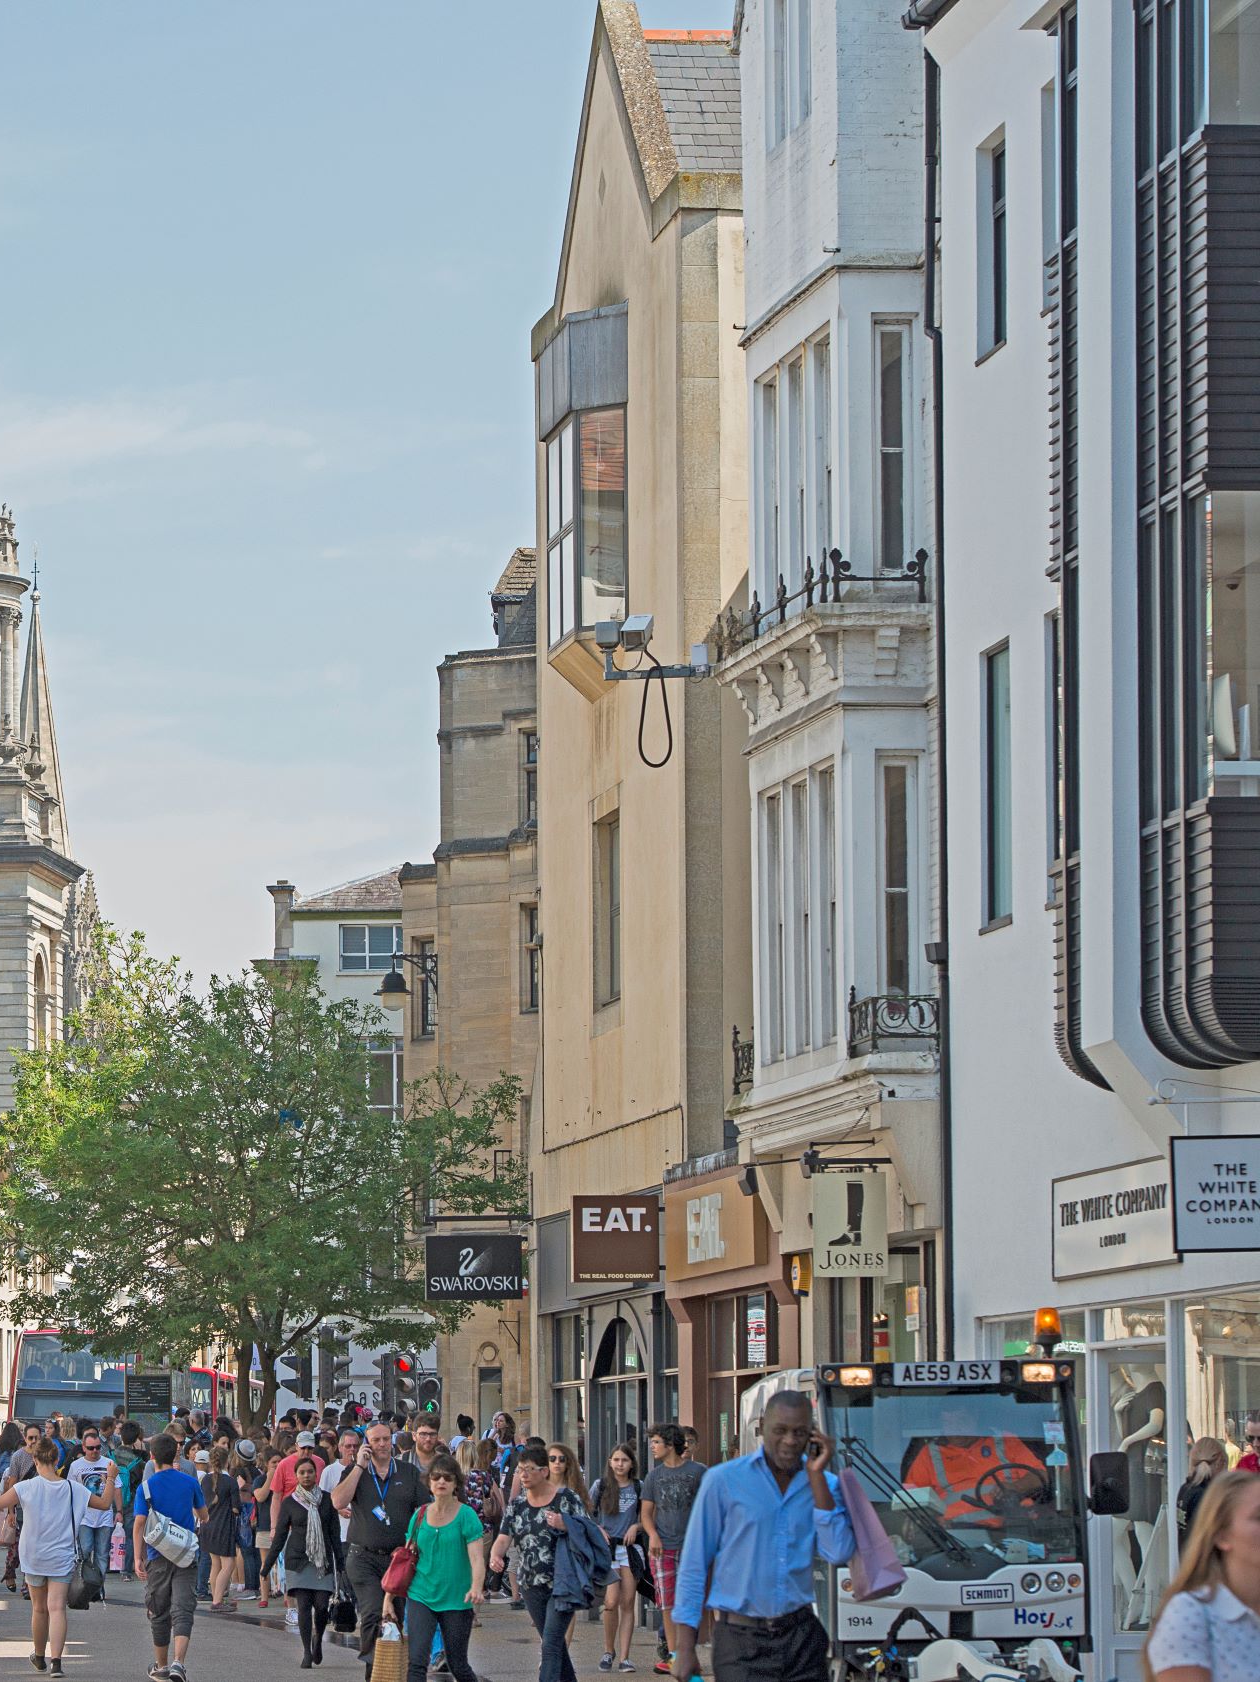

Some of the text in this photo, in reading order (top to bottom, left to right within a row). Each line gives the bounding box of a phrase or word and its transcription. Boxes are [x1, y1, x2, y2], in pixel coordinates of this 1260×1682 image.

[1213, 1163, 1248, 1176] THE
[1198, 1181, 1257, 1194] WHITE
[1060, 1183, 1167, 1227] THE WHITE COMPANY
[1186, 1200, 1260, 1213] COMPAN
[581, 1207, 652, 1232] EAT.
[1207, 1216, 1254, 1224] LONDON
[687, 1192, 725, 1264] EAT.
[1099, 1232, 1127, 1247] LONDON
[430, 1276, 518, 1292] SWAROVSKI
[902, 1363, 992, 1382] AE59 ASX
[966, 1588, 1009, 1600] SCHMIDT
[847, 1617, 874, 1627] 1914
